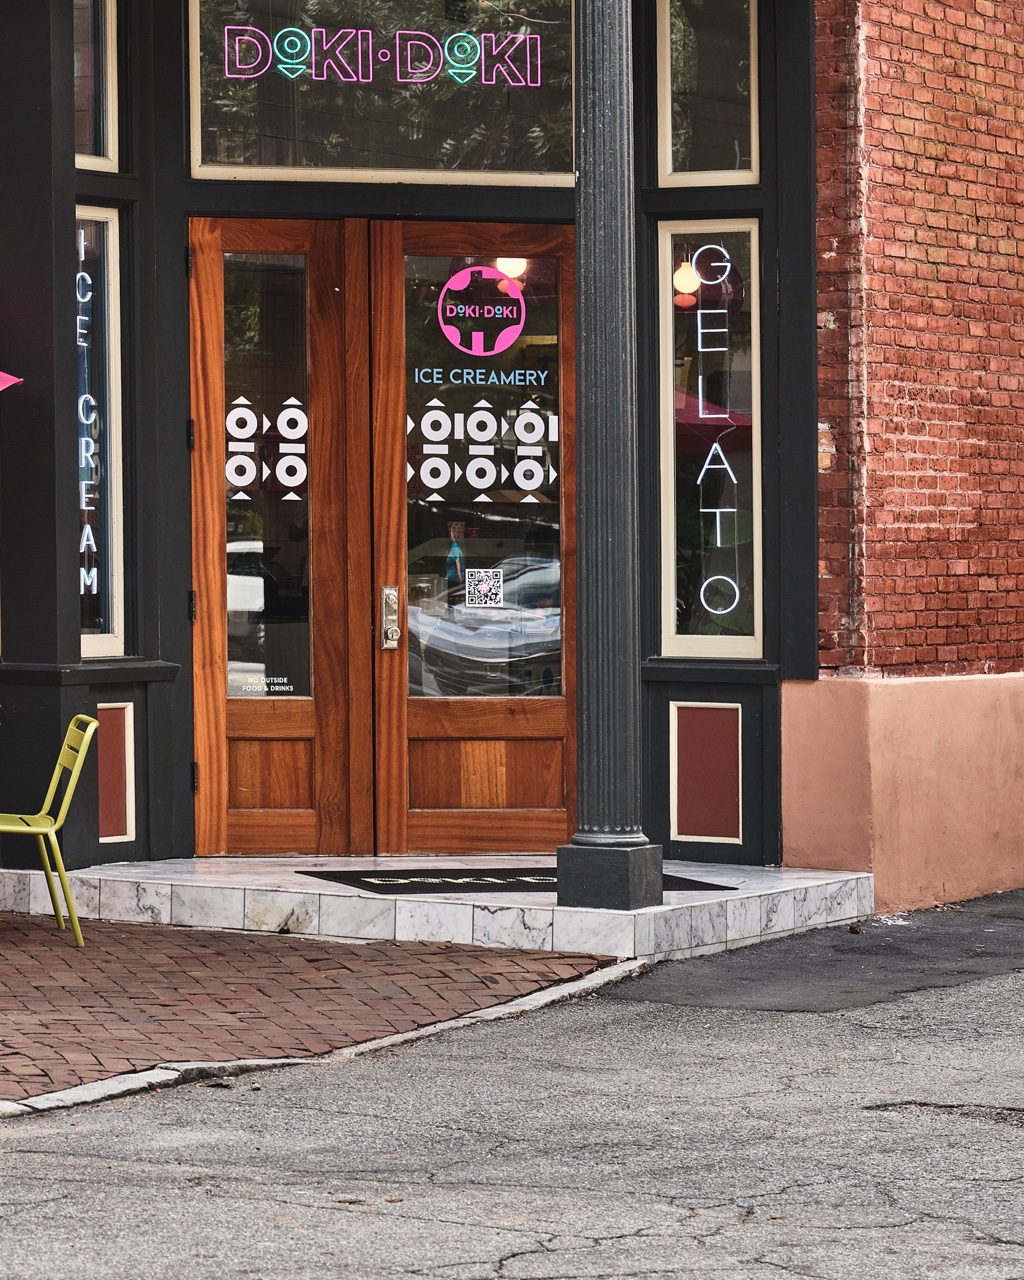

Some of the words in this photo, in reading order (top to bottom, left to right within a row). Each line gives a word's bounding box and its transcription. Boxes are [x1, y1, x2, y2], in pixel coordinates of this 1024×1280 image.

[76, 229, 93, 347] ICE
[414, 368, 443, 384] ICE
[449, 368, 549, 386] CREAMERY
[691, 244, 740, 614] GELATO
[78, 393, 98, 595] CREAM
